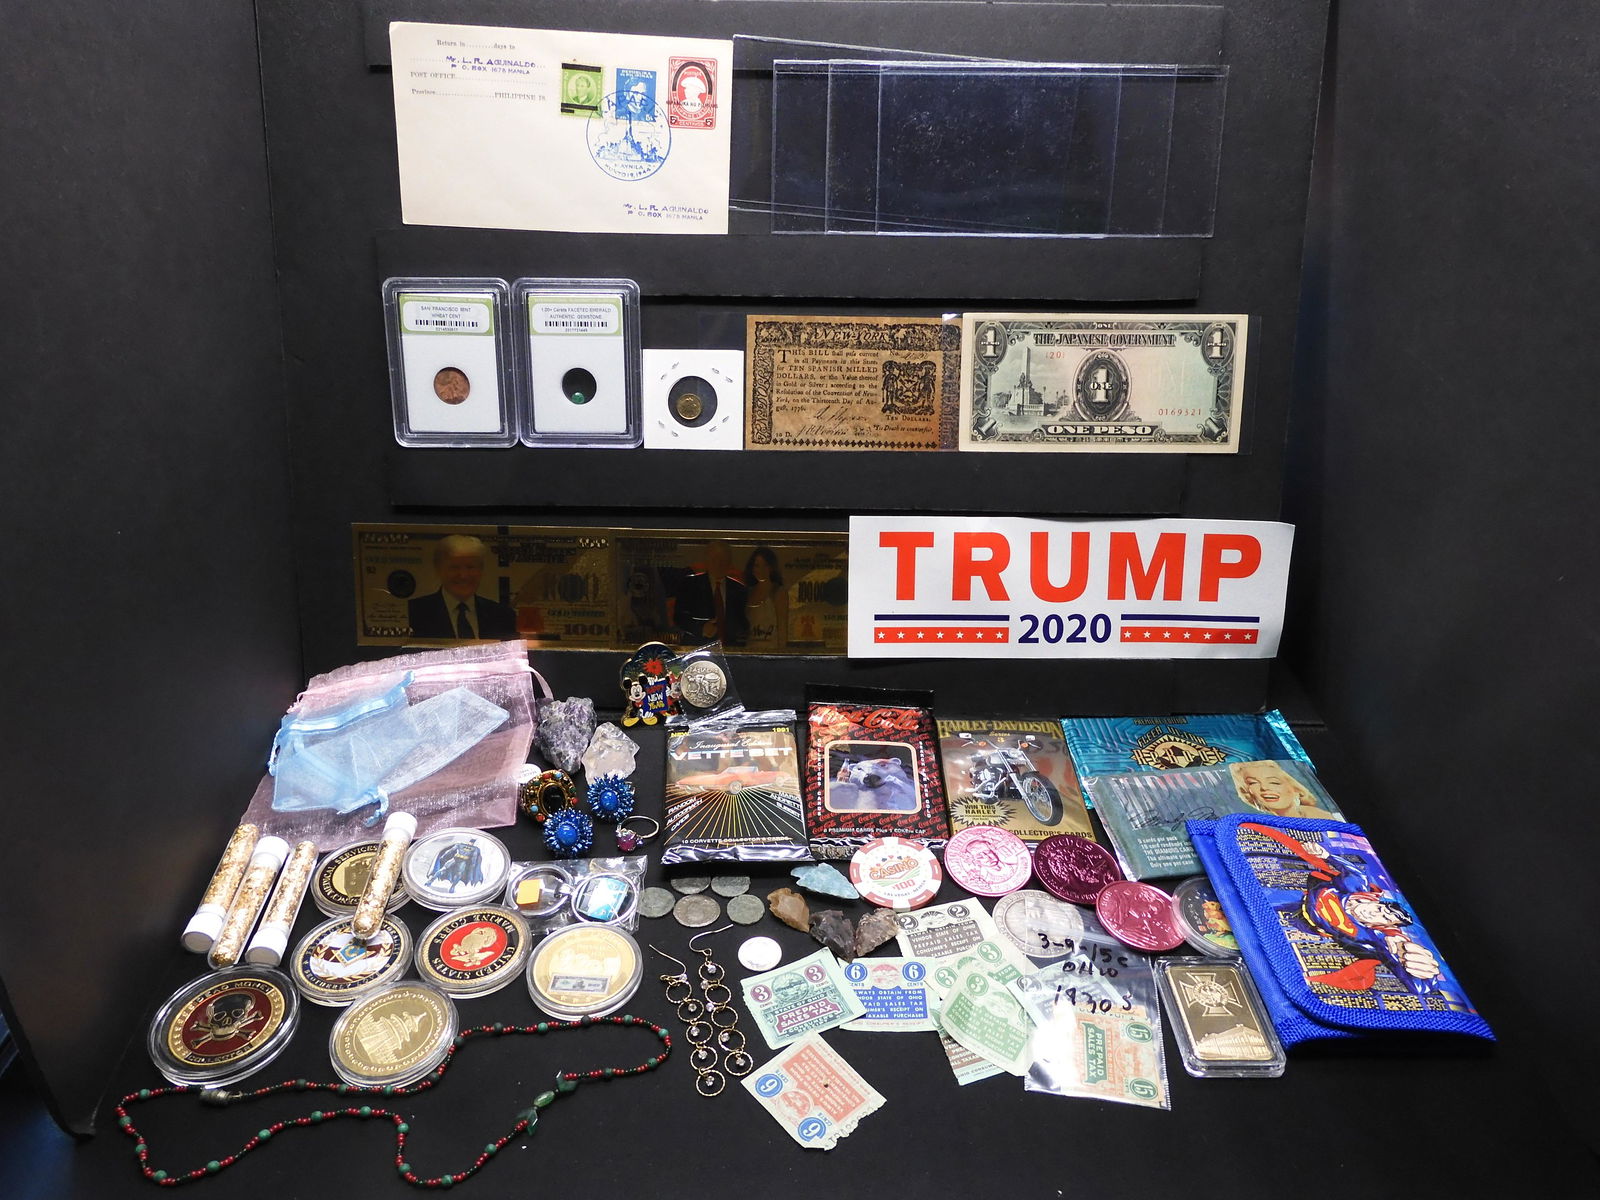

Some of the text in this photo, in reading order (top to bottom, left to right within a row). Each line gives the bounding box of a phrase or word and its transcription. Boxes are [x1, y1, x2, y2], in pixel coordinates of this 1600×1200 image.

[1034, 334, 1176, 347] THE JAPANESE GOVERNMENT
[1090, 382, 1112, 391] ONE
[1048, 426, 1152, 435] ONE PESO
[878, 531, 1262, 603] TRUMP
[1018, 613, 1112, 644] 2020
[936, 719, 1066, 740] HARLEY-DAVIDSON
[1137, 726, 1163, 748] FLEER
[670, 747, 792, 760] VETTE SET
[335, 846, 378, 865] SERVICES
[869, 858, 919, 880] CASINO
[892, 879, 916, 890] $100
[951, 905, 966, 918] 2
[434, 914, 516, 945] MARINE CORPS
[901, 916, 914, 928] 2
[914, 940, 941, 949] PREPAID
[984, 946, 996, 960] 3
[476, 946, 516, 978] UNITED
[1062, 962, 1119, 978] OHIO
[808, 966, 822, 981] 3
[851, 964, 861, 980] 6
[908, 964, 919, 980] 6
[940, 970, 954, 985] 3
[971, 976, 984, 992] 3
[754, 986, 768, 1001] 3
[781, 1005, 834, 1028] SALES TAX
[782, 1000, 826, 1020] PREPAID
[1128, 1027, 1150, 1038] 15
[1088, 1027, 1096, 1078] SALES TAX
[1096, 1032, 1104, 1076] PREPAID
[1133, 1084, 1154, 1096] 15
[759, 1076, 822, 1140] 6 6
